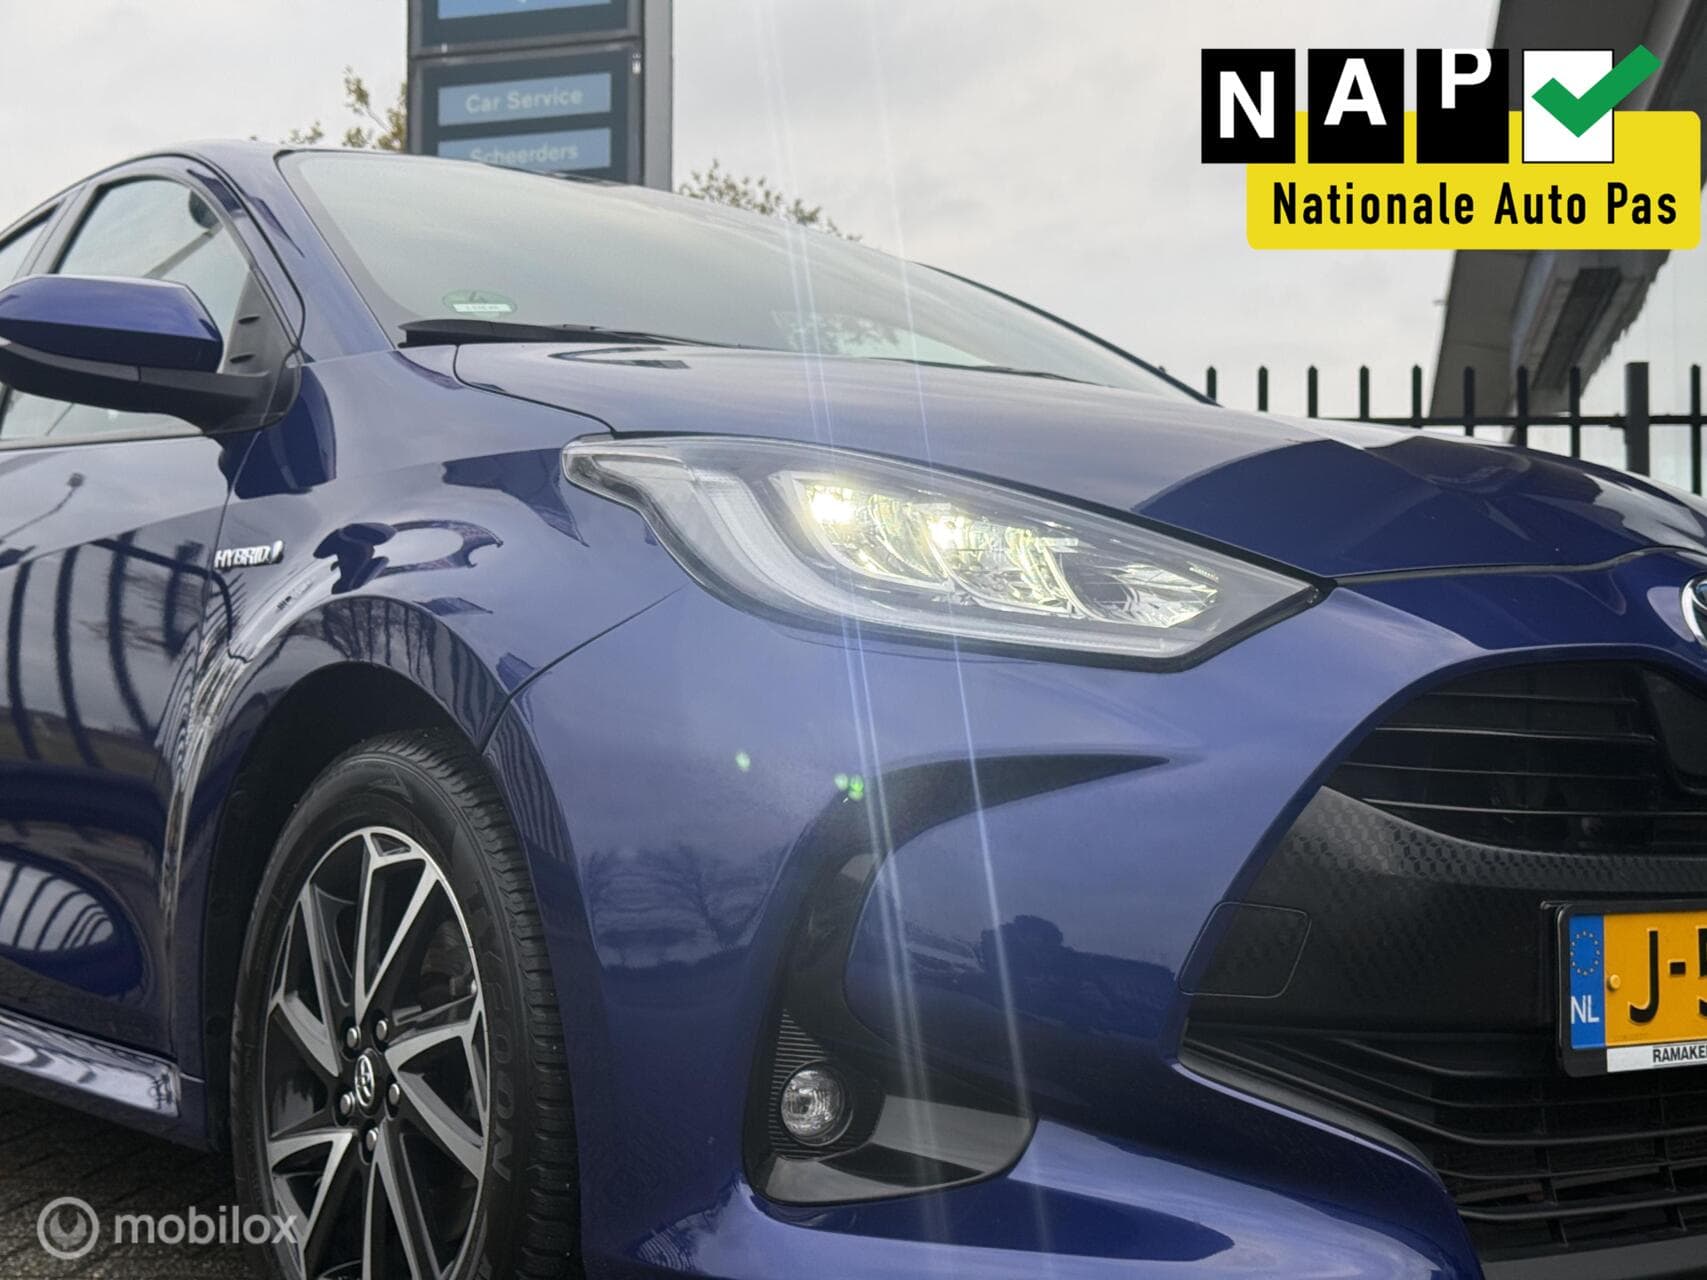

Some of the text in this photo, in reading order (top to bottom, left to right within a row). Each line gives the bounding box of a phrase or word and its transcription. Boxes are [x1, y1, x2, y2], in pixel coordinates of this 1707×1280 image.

[465, 87, 582, 114] Car Service
[1629, 927, 1707, 1025] J-
[1570, 995, 1600, 1024] NL
[1652, 1045, 1707, 1063] RAMAKE
